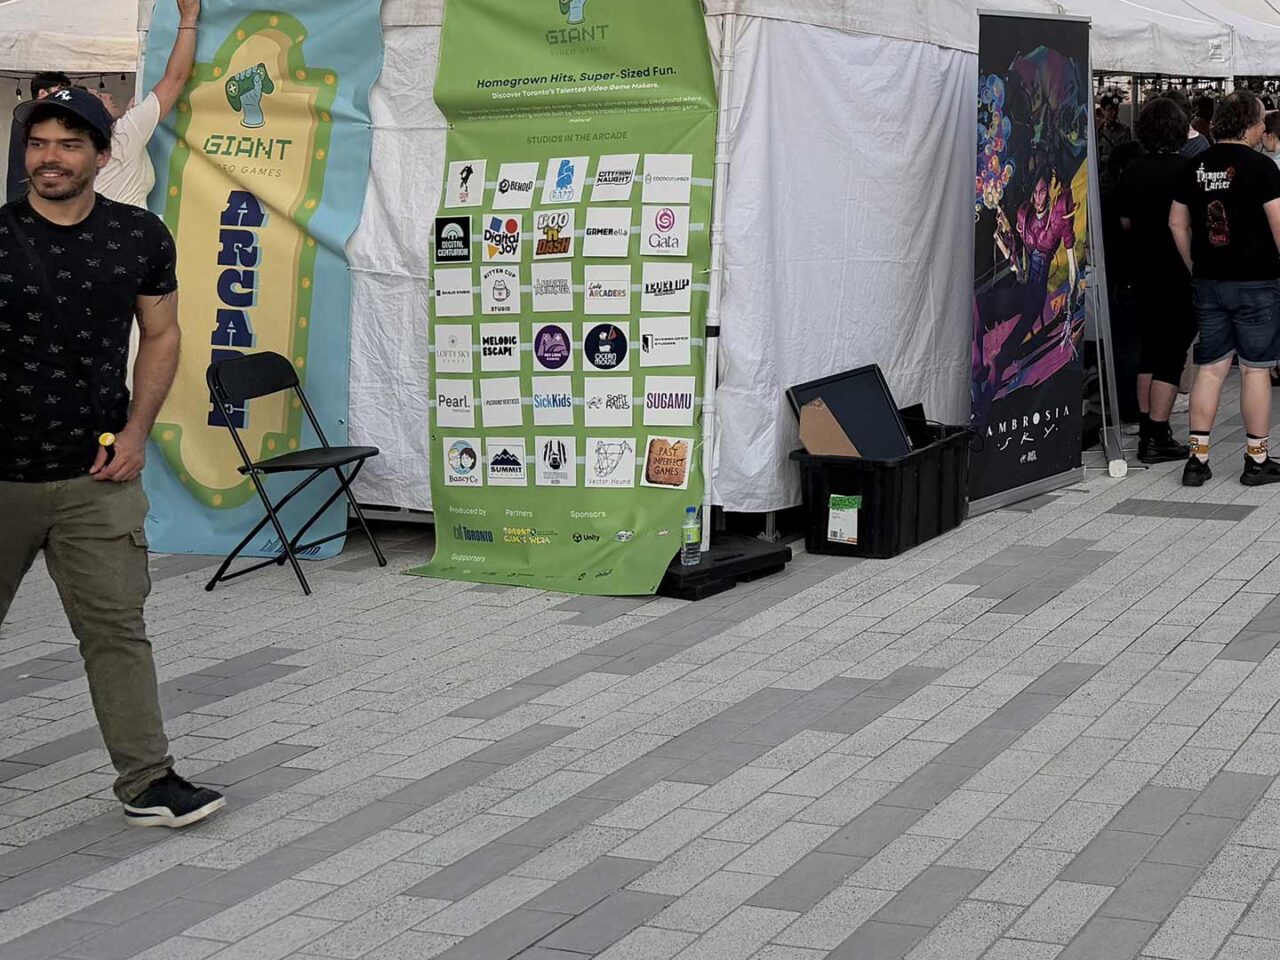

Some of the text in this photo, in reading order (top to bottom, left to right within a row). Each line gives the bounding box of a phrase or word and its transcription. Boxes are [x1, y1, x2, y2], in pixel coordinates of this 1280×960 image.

[545, 25, 609, 44] GIANT
[477, 66, 677, 88] Homegrown Hits, Super-Sized Fun.
[492, 91, 521, 100] Discover
[522, 88, 555, 97] Toronto's
[555, 85, 587, 95] Talented
[588, 84, 609, 92] Video
[609, 83, 630, 91] Game
[527, 131, 628, 144] STUDIOS IN THE ARCADE
[203, 134, 292, 160] GIANT
[241, 166, 282, 178] GAMES
[510, 181, 534, 192] BEHOLD
[484, 230, 519, 245] Digital
[586, 228, 628, 236] GAMERella
[441, 240, 464, 249] DIGITAL
[499, 243, 518, 255] Joy
[536, 237, 571, 255] DASH
[484, 268, 517, 279] KITTEN CUP
[589, 289, 627, 297] ARCADERS
[482, 336, 517, 346] MELODIC
[594, 352, 617, 360] OCEAN
[533, 393, 572, 408] SickKids
[646, 392, 692, 409] SUGAMU
[986, 405, 1070, 438] AMBROSIA
[658, 446, 678, 457] PAST
[653, 456, 685, 467] IMPERFECT
[653, 465, 679, 476] GAMES
[449, 506, 487, 517] Produced by
[505, 509, 533, 517] Partners
[570, 510, 606, 519] Sponsors
[583, 533, 600, 541] Unity
[451, 552, 485, 562] Supporters
